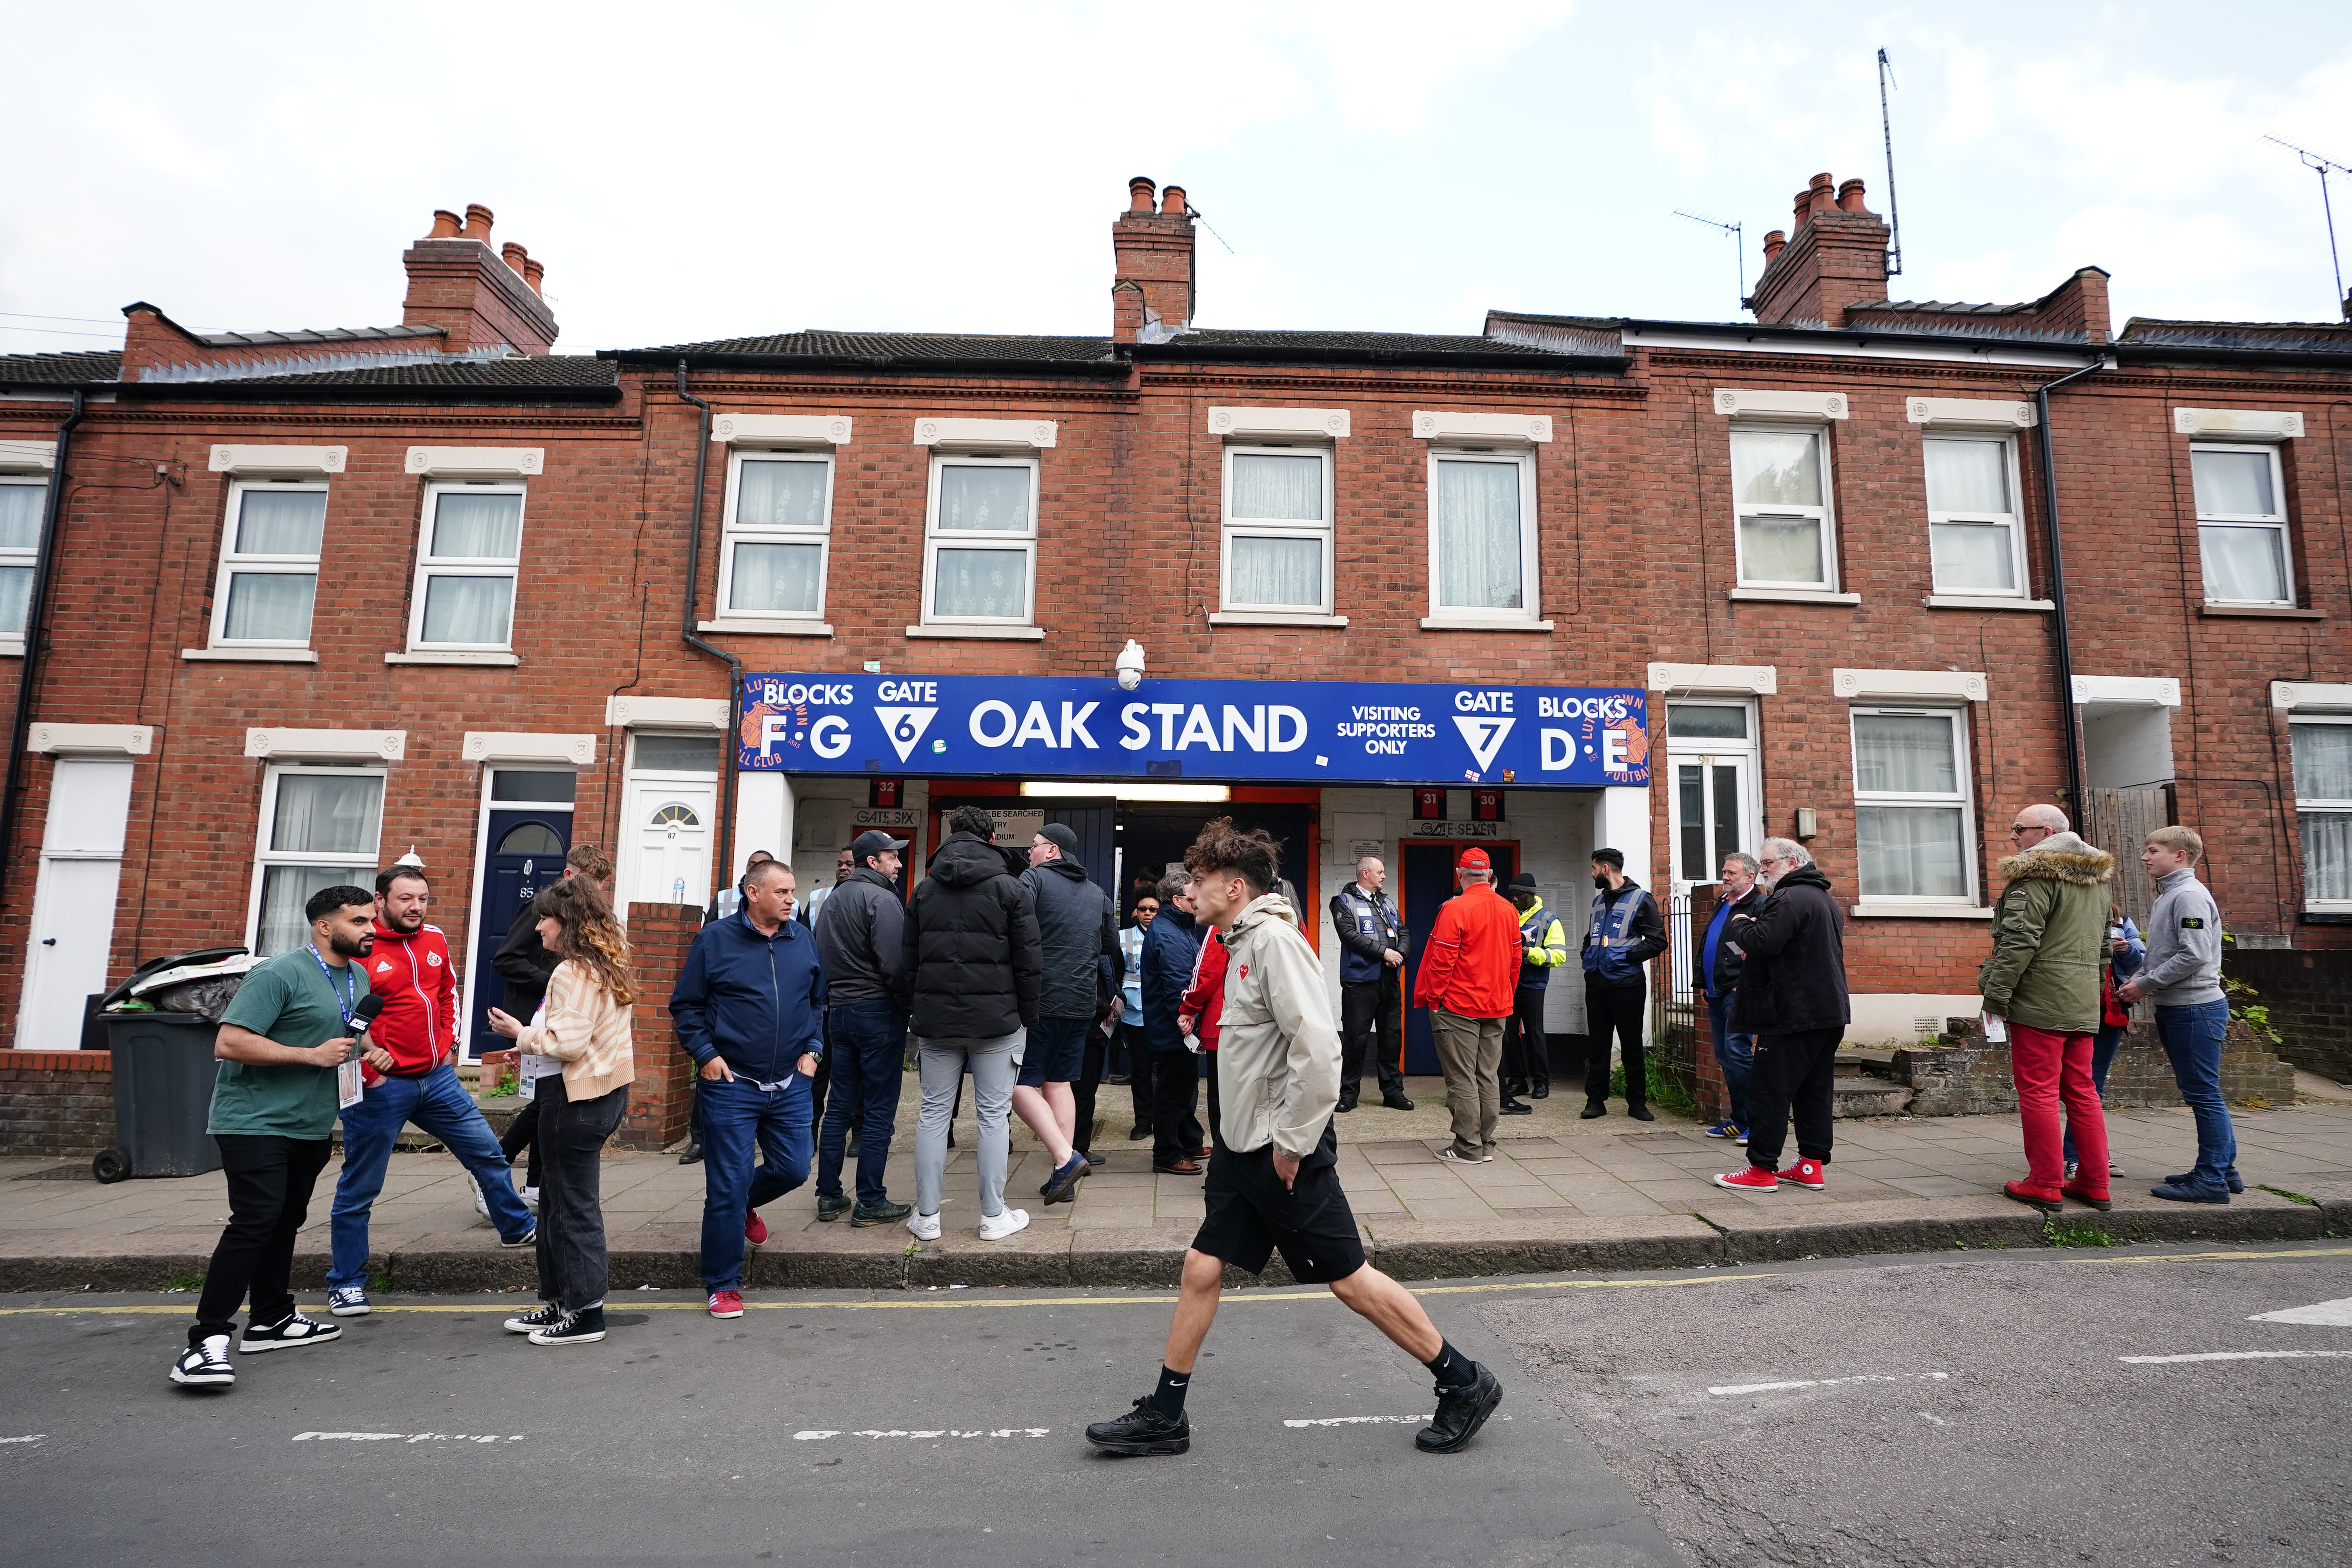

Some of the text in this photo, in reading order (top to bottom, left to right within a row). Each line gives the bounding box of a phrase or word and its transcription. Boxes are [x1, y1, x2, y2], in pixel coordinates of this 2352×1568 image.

[764, 684, 853, 705] BLOCKS
[878, 681, 937, 702] GATE
[1455, 691, 1513, 712] GATE
[1539, 697, 1627, 719] BLOCKS
[1352, 706, 1421, 721] VISITING
[895, 714, 915, 742] 6
[969, 700, 1308, 752] OAK STAND
[1337, 722, 1436, 738] SUPPORTERS
[788, 738, 800, 749] 1885
[1479, 724, 1501, 752] 7
[1366, 740, 1408, 754] ONLY
[754, 753, 782, 767] CLUB
[1588, 752, 1598, 762] EST
[880, 782, 894, 792] 32
[1424, 793, 1436, 804] 31
[1481, 795, 1495, 805] 30
[895, 812, 914, 824] SIX
[1458, 822, 1497, 836] SEVEN
[520, 887, 533, 898] 85
[352, 1018, 368, 1027] SPORT
